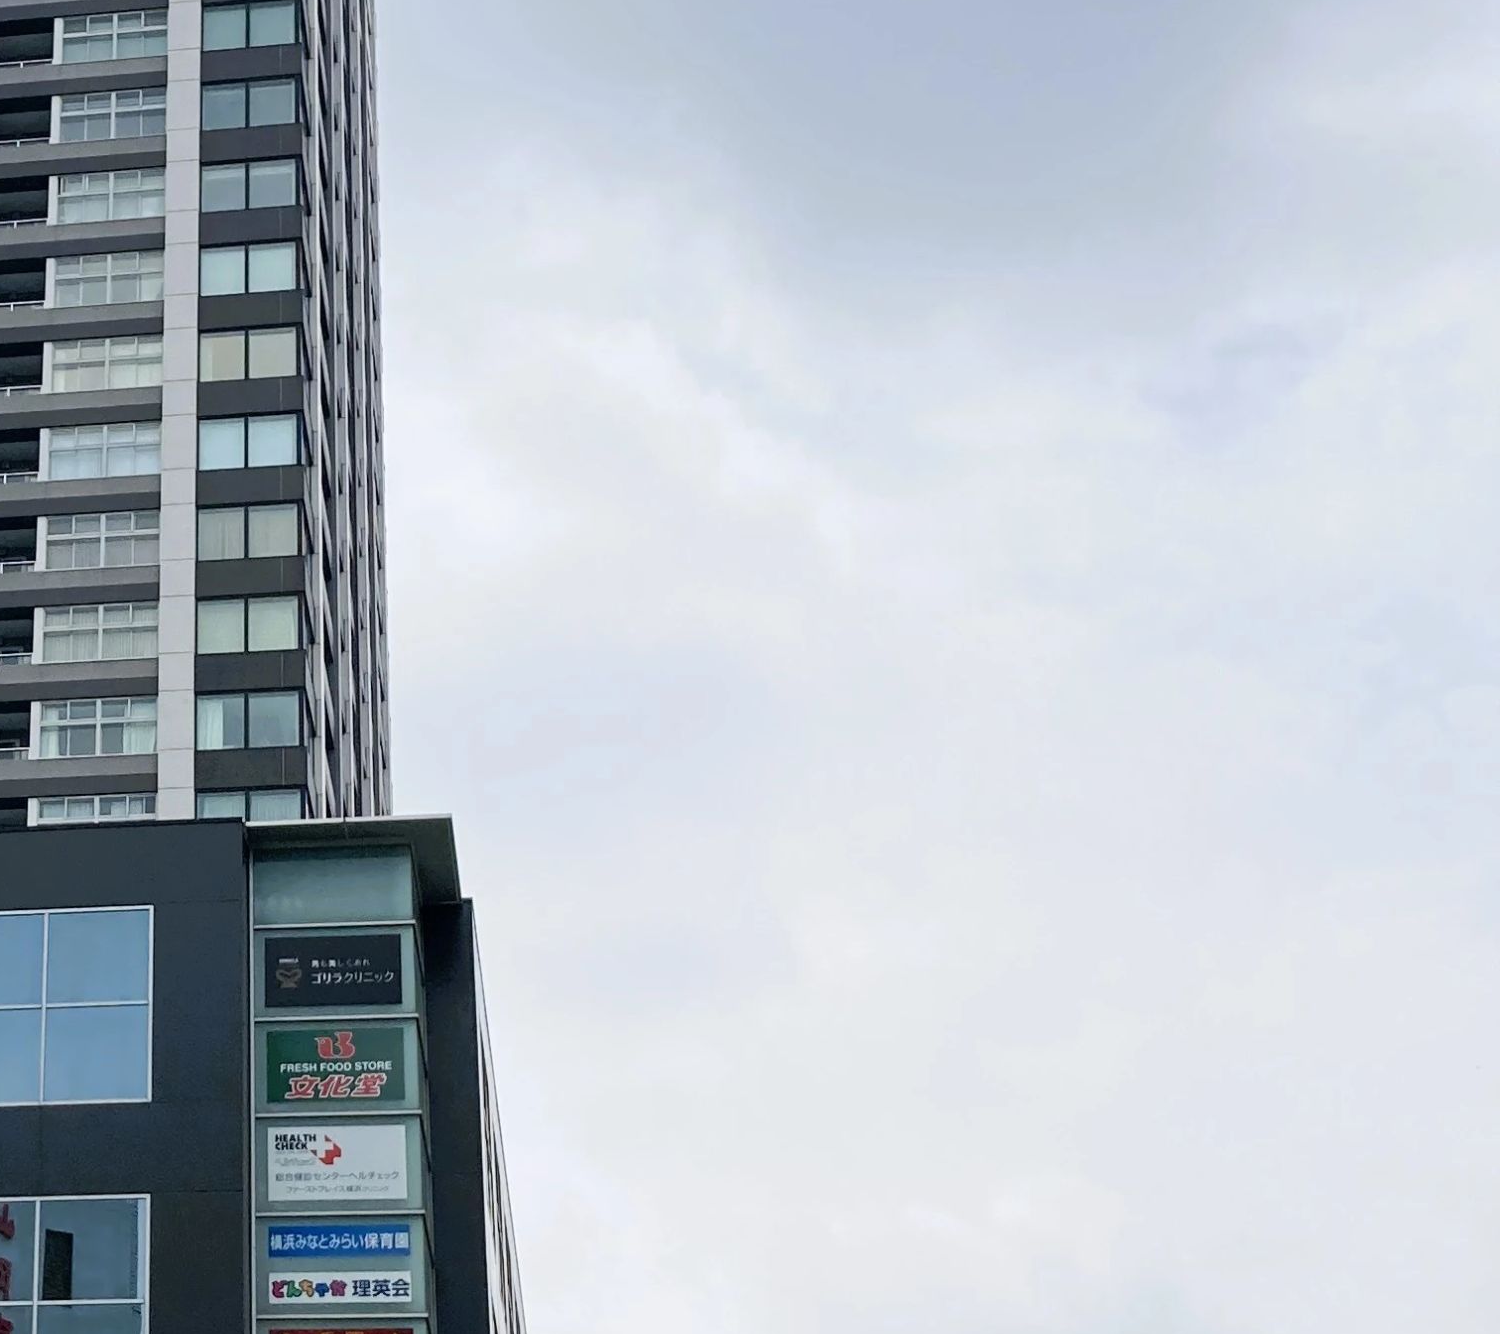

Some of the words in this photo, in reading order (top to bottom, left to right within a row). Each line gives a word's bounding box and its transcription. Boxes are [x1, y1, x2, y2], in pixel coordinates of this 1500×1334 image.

[311, 971, 394, 985] ゴリラクリニック
[280, 1063, 317, 1073] FRESH
[320, 1062, 351, 1072] FOOD
[354, 1061, 392, 1071] STORE
[284, 1073, 387, 1099] 文化堂
[275, 1134, 317, 1142] HEALTH
[275, 1142, 308, 1151] CHECK
[271, 1232, 409, 1250] 横浜みなとみらい保育園
[352, 1279, 409, 1297] 理英会
